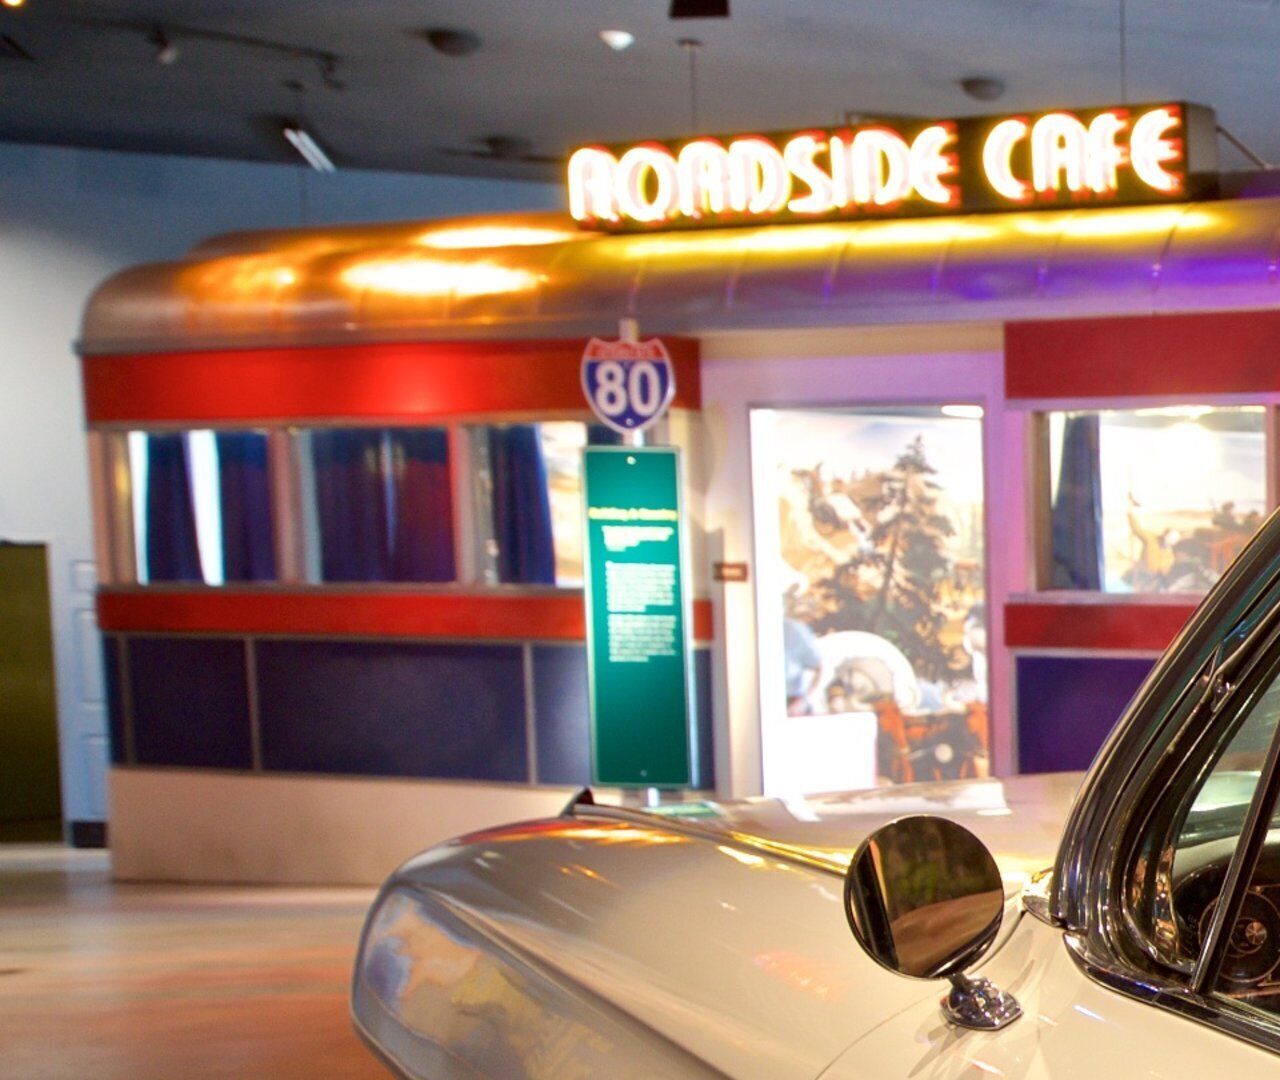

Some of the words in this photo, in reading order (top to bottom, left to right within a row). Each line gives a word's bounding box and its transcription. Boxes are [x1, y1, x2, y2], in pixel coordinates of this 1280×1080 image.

[566, 120, 959, 227] ROADSIDE
[981, 103, 1183, 203] CAFE
[595, 361, 660, 416] 80
